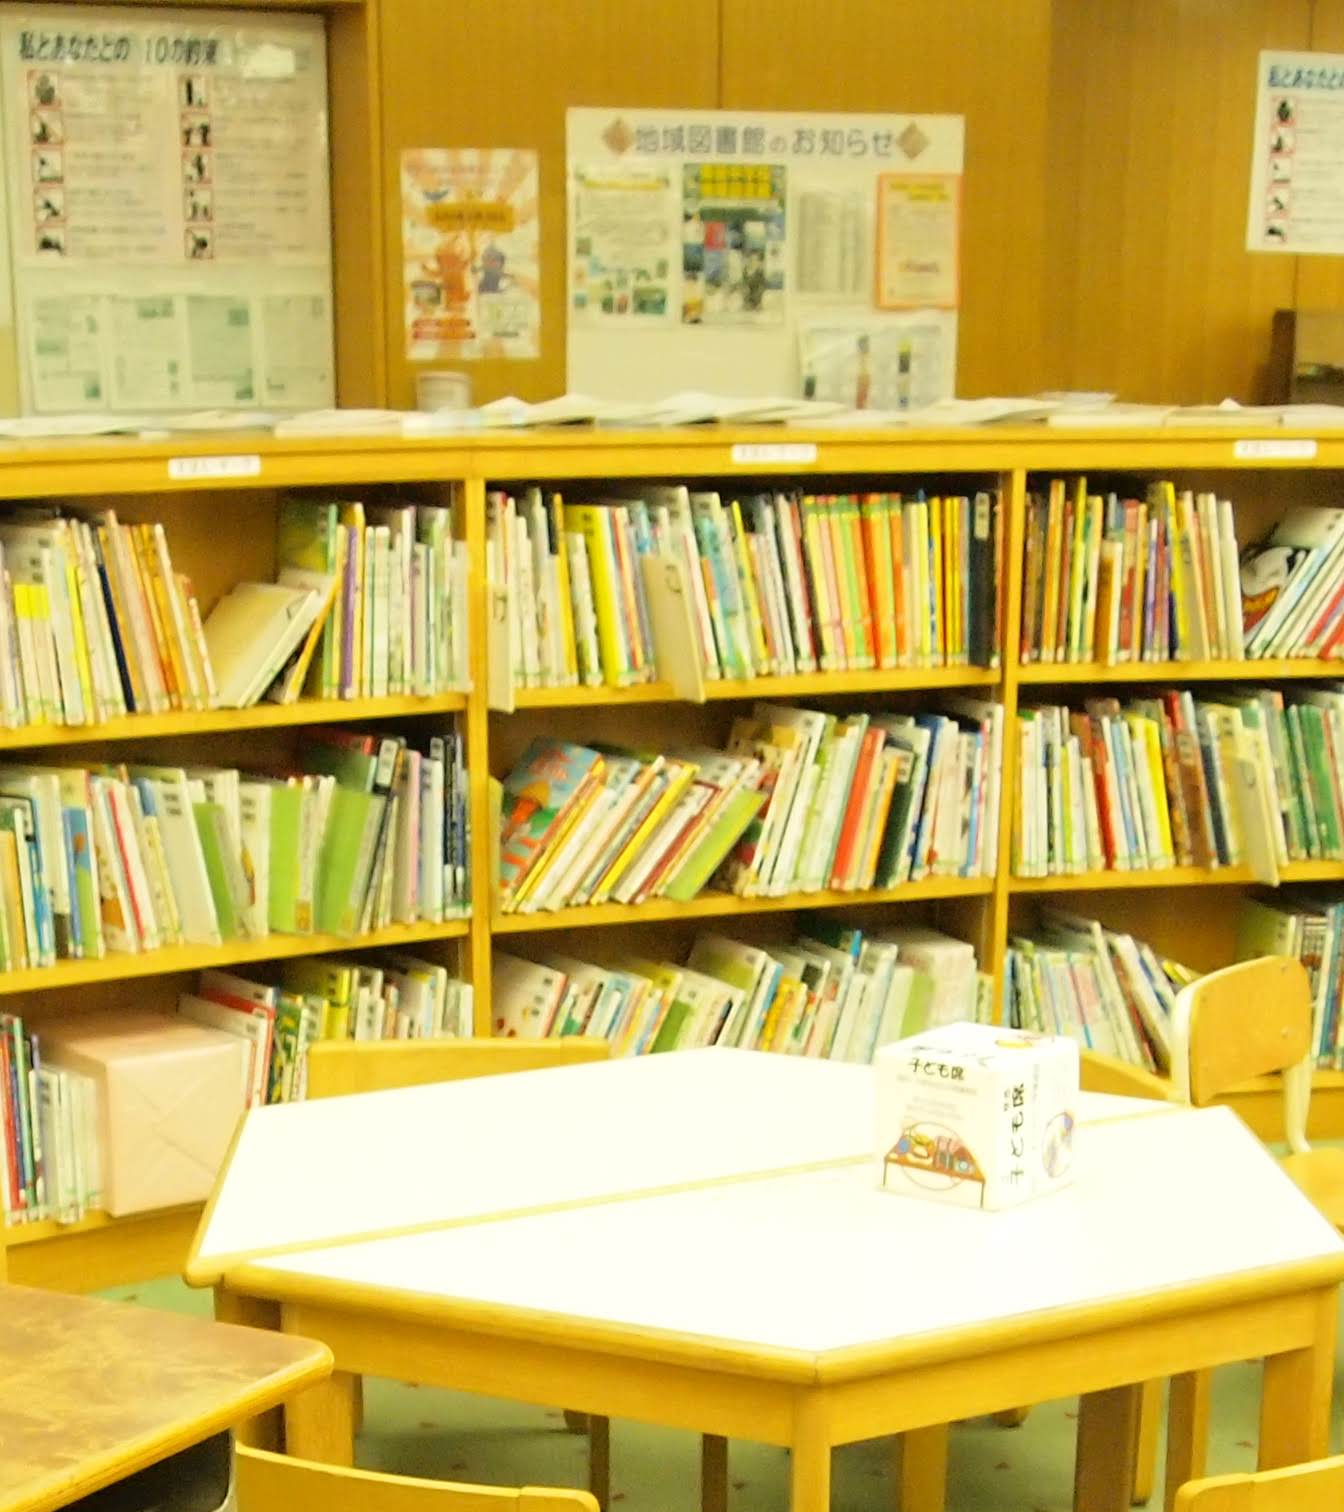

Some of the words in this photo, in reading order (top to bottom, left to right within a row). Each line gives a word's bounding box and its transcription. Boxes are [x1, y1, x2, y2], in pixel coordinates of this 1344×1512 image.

[635, 124, 894, 157] 地域図書館のお知らせ
